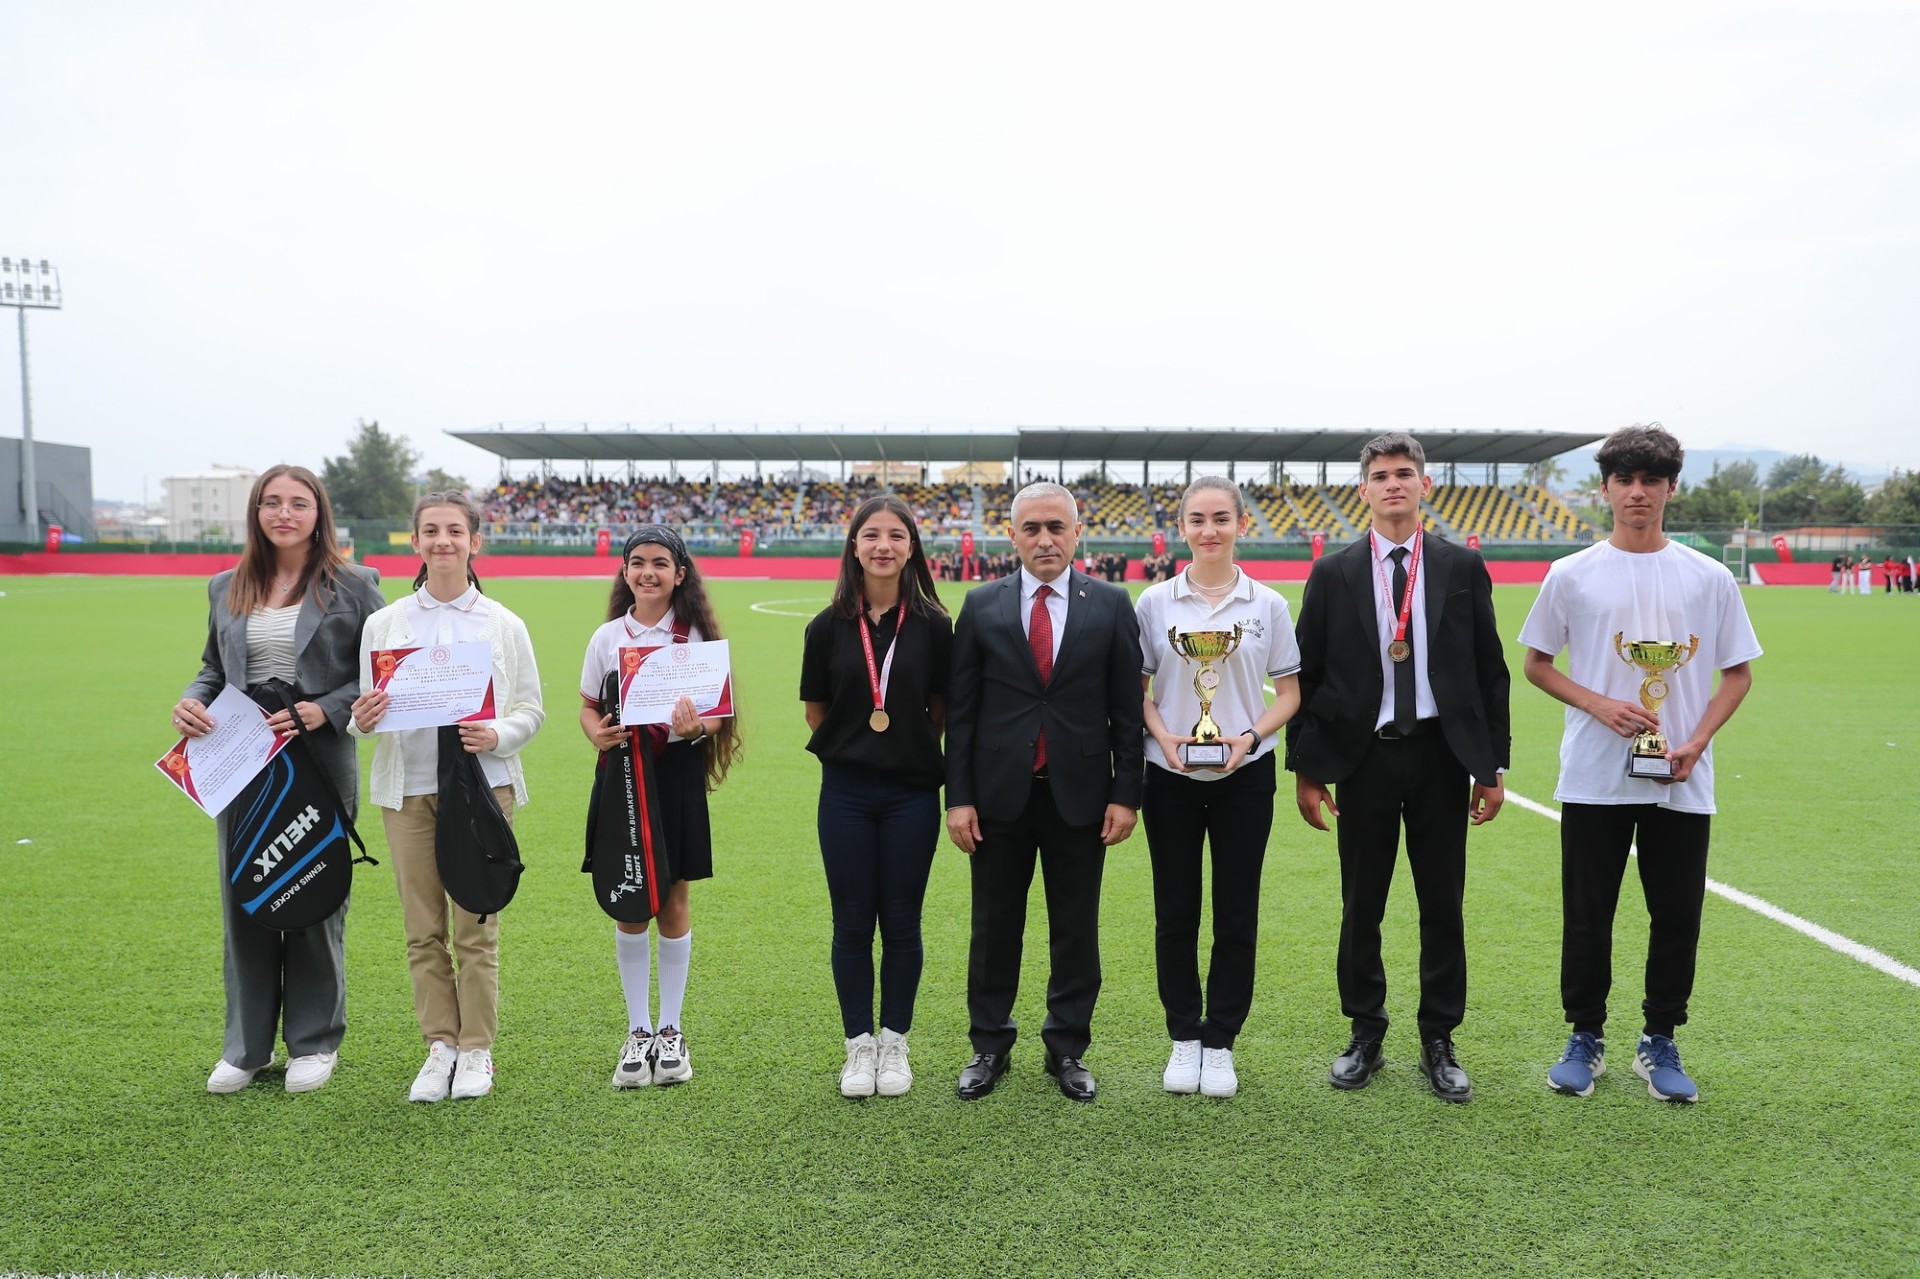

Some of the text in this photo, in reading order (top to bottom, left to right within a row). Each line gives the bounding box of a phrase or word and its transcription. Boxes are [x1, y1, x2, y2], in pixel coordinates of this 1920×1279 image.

[253, 804, 321, 877] HELIX
[270, 861, 327, 912] TENNIS RACKET
[624, 854, 634, 880] Can
